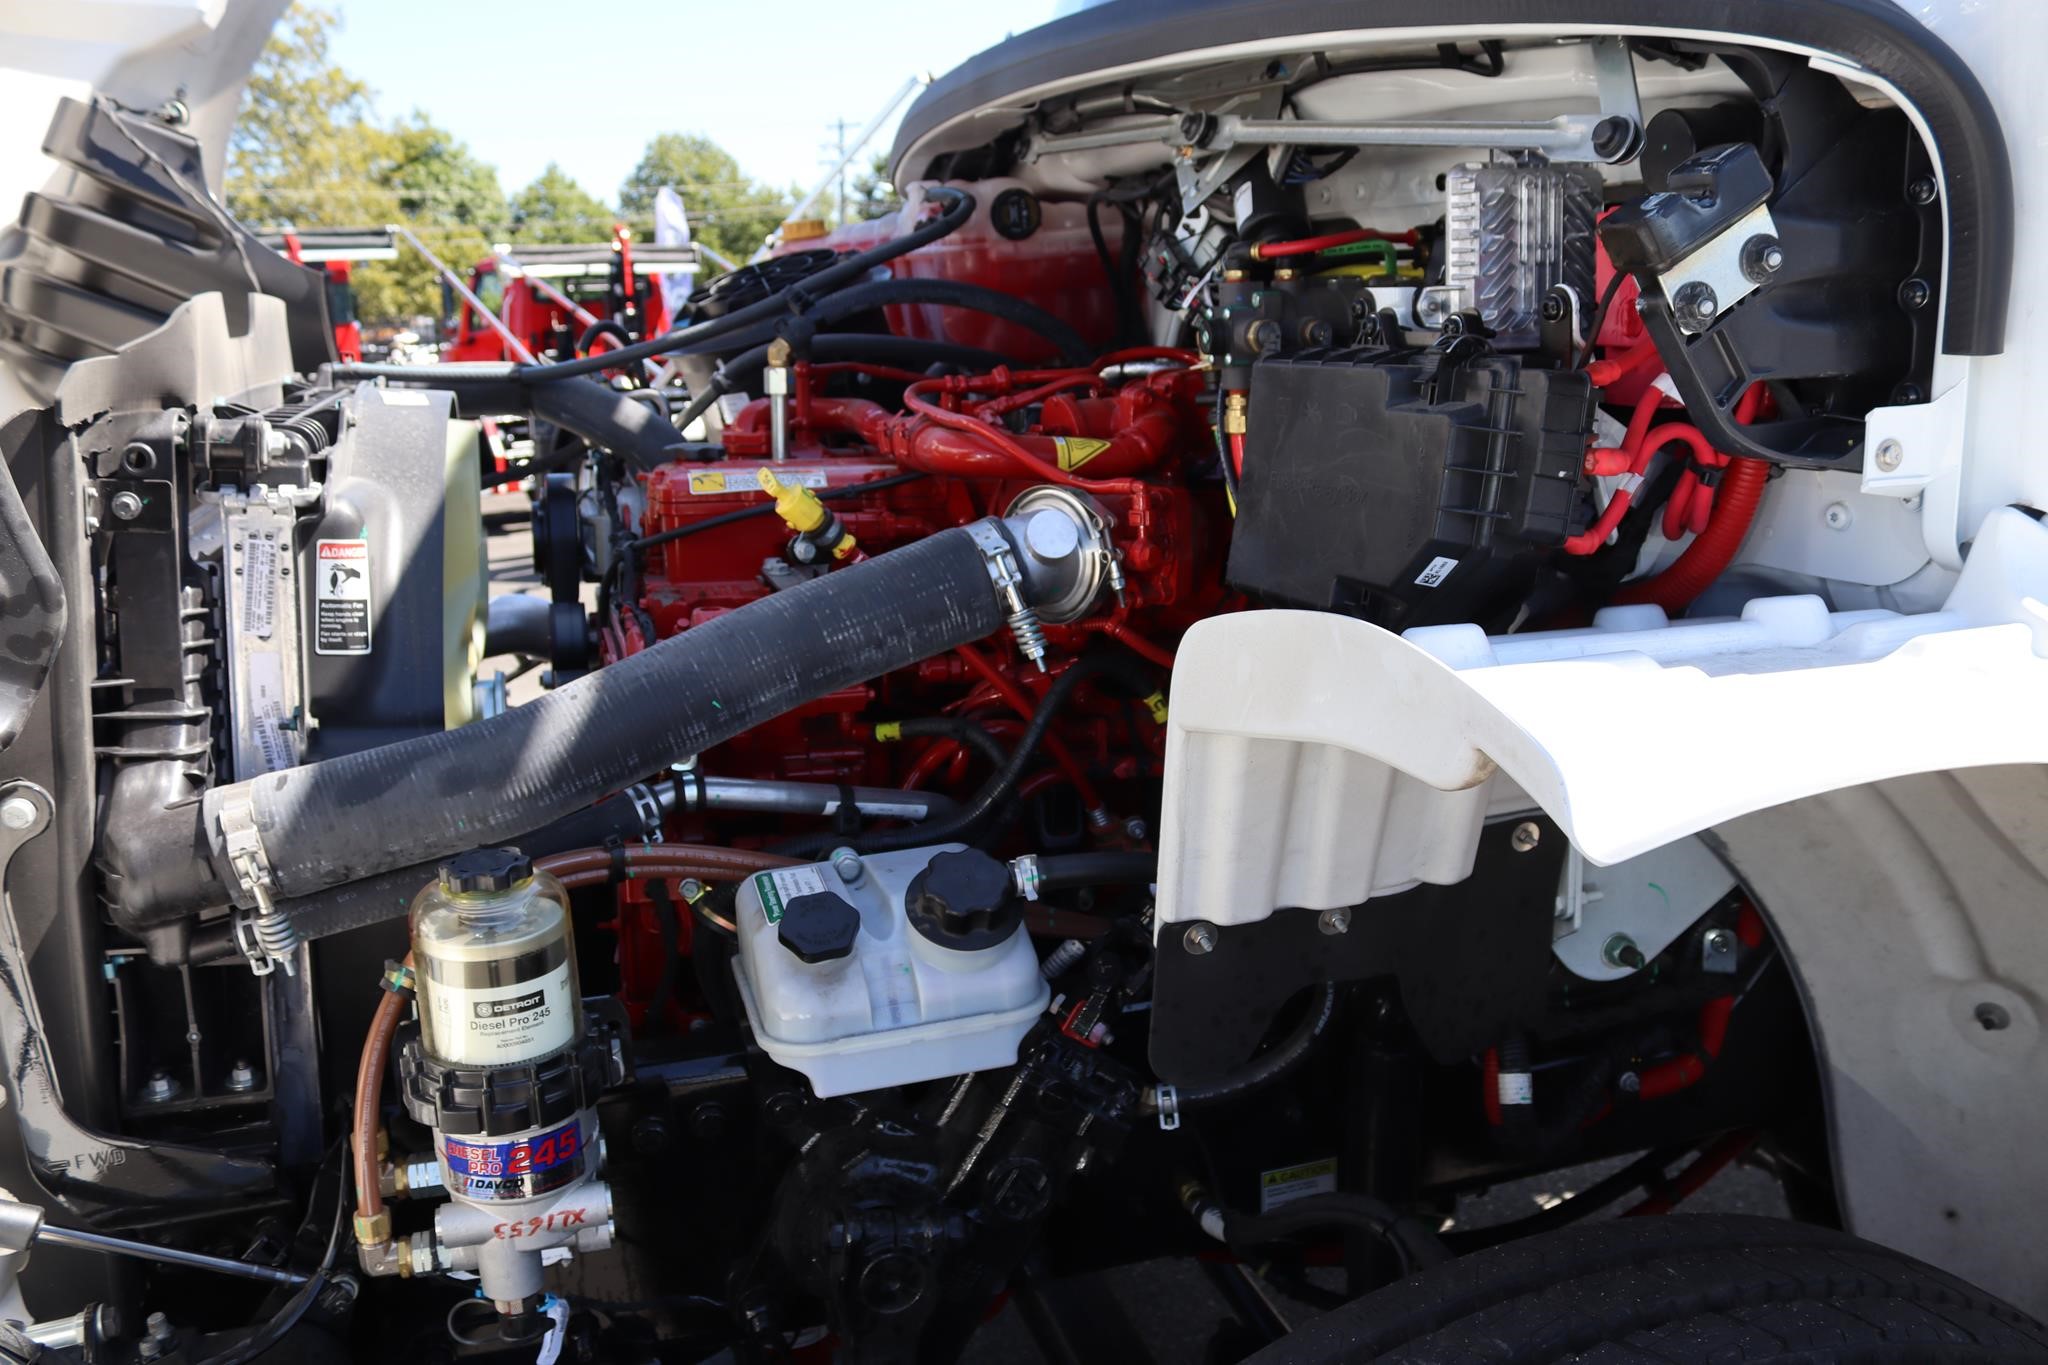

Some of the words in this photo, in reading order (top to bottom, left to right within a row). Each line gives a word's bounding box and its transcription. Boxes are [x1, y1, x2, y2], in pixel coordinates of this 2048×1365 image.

[331, 547, 365, 557] DANG
[494, 995, 541, 1012] DETROIT
[470, 1020, 505, 1031] Diesel
[509, 1016, 529, 1027] Pro
[532, 1007, 551, 1022] 245
[74, 1147, 126, 1169] FWD
[447, 1141, 500, 1161] DIESEL
[507, 1128, 577, 1174] 245
[468, 1160, 503, 1176] PRO
[474, 1177, 525, 1190] DAVCO
[493, 1208, 586, 1240] XL1653
